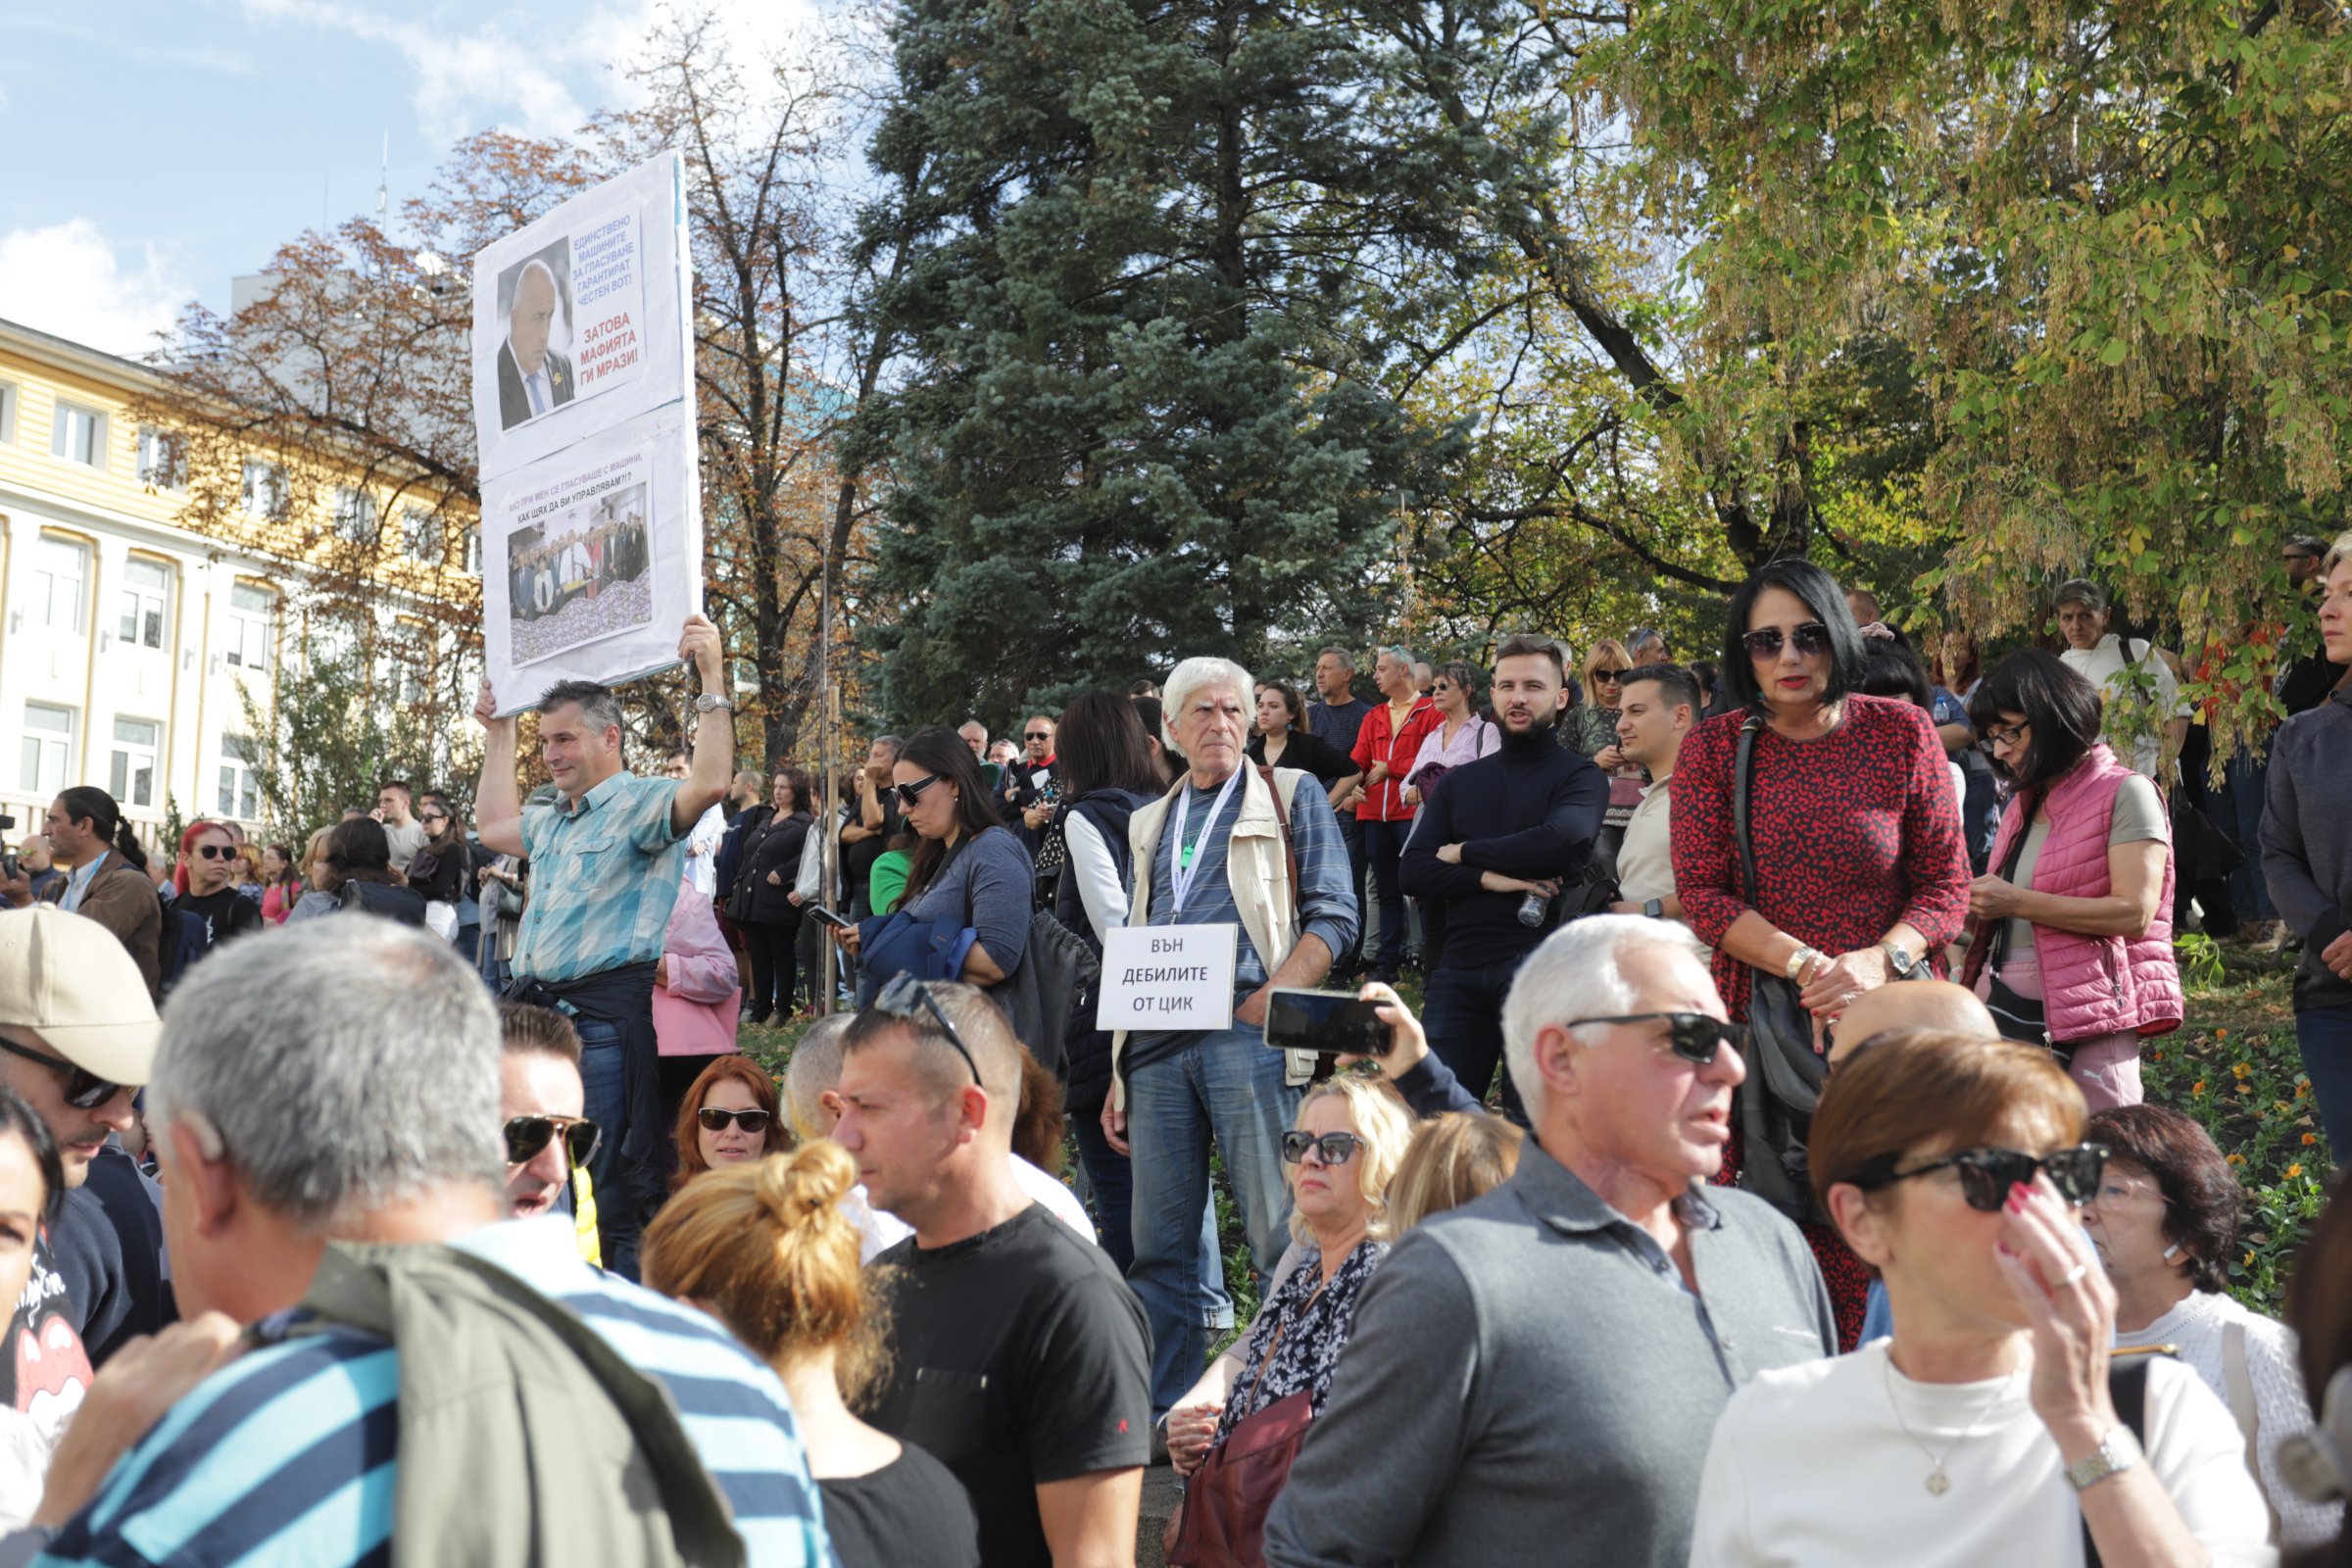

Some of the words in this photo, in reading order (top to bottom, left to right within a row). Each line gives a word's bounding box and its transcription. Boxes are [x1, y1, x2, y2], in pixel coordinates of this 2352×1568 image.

[573, 215, 630, 251] ЕДИНСТВЕНО
[578, 230, 626, 263] МАШИНИТЕ
[572, 268, 583, 281] ЗА
[584, 242, 634, 274] ГЛАСУВАНЕ
[577, 259, 630, 294] ГАРАНТИРАТ
[578, 283, 610, 306] ЧЕСТЕН
[612, 273, 632, 291] ВОТ!
[584, 312, 630, 344] ЗАТОВА
[580, 329, 636, 366] МАФИЯТА
[580, 368, 594, 386] ГИ
[597, 348, 638, 379] МРАЗИ!
[510, 501, 520, 512] АКО
[521, 494, 534, 508] ПРИ
[535, 488, 549, 502] МЕН
[550, 484, 560, 496] СЕ
[561, 467, 603, 492] ГЛАСУВАШЕ
[604, 466, 609, 474] С
[610, 452, 643, 471] МАШИНИ,
[517, 512, 530, 524] КАК
[531, 504, 548, 518] ЩЯХ
[549, 501, 560, 513] ДА
[560, 495, 570, 508] ВИ
[572, 471, 632, 503] УПРАВЛЯВАМ?!?
[1152, 938, 1183, 953] ВЪН
[1122, 966, 1208, 986] ДЕБИЛИТЕ
[1133, 997, 1155, 1011] ОТ
[1158, 996, 1193, 1014] ЦИК
